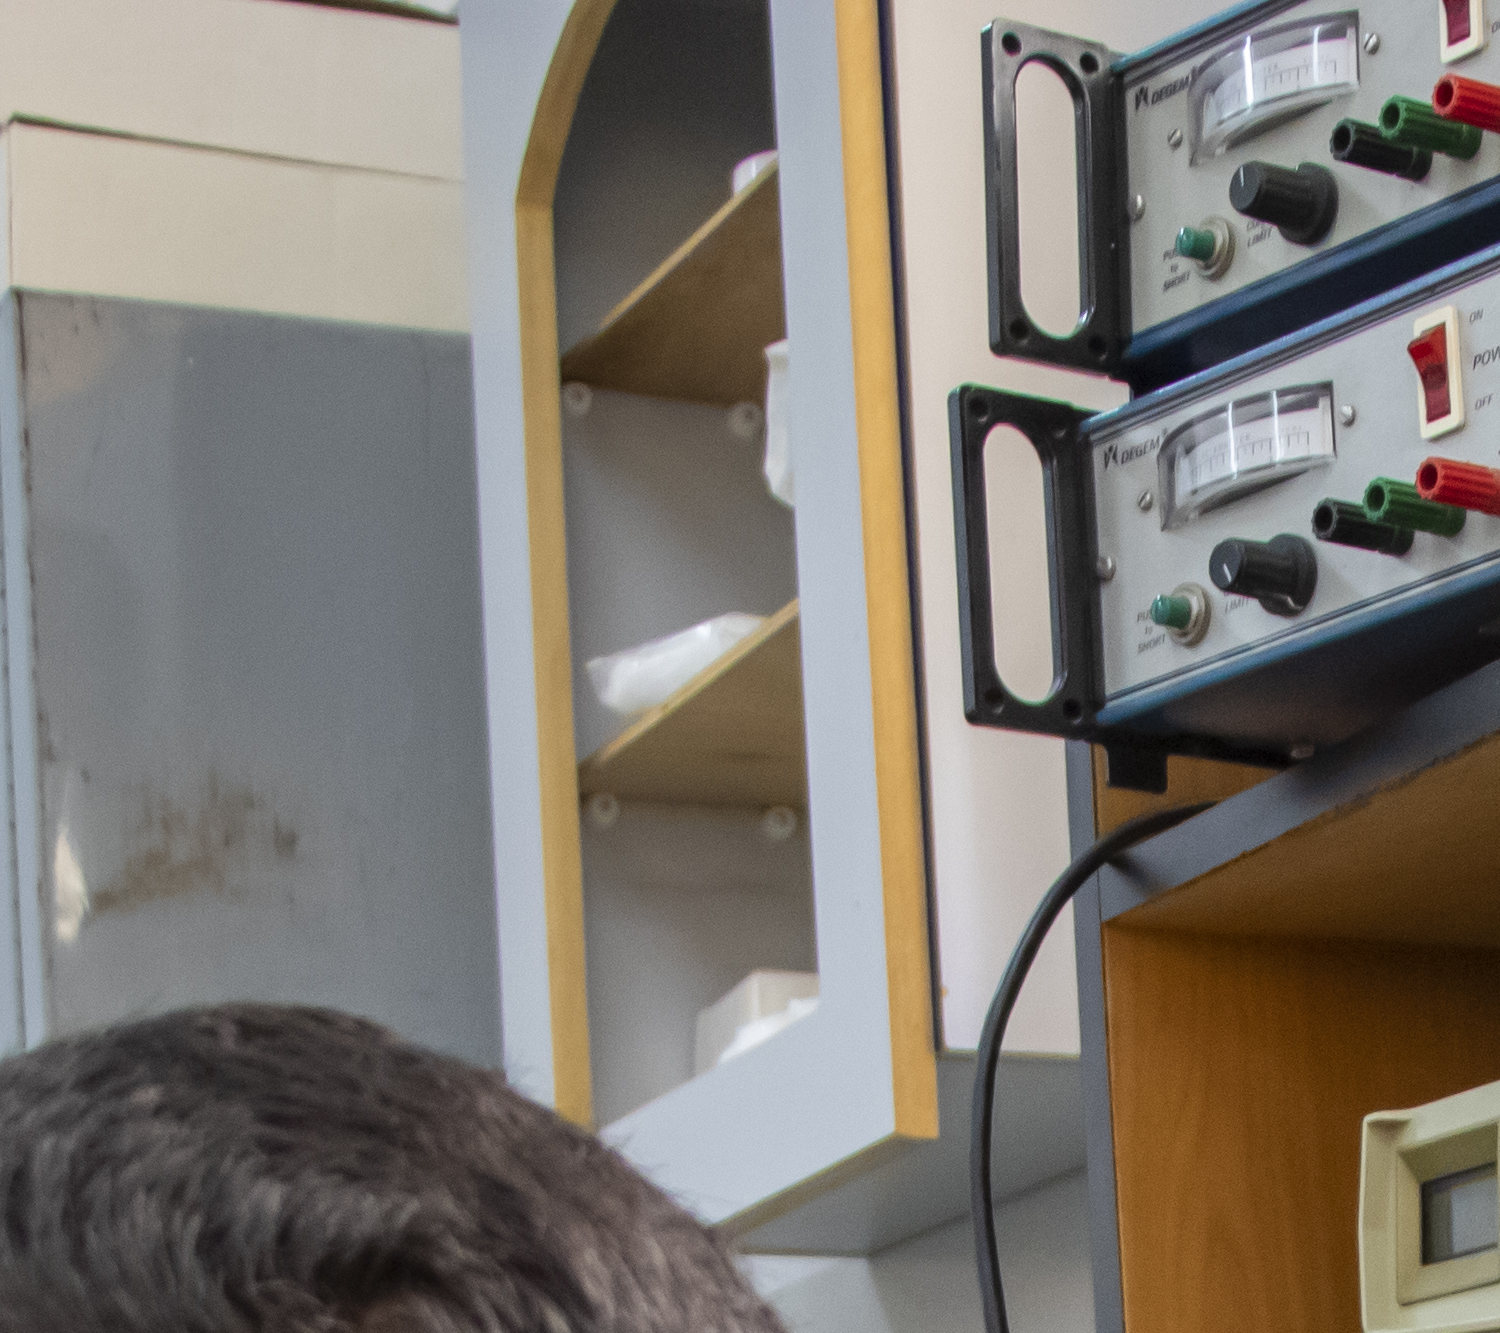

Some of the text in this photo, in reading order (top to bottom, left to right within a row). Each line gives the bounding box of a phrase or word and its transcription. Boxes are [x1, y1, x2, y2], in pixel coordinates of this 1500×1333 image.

[1151, 75, 1189, 107] DEGEM
[1474, 394, 1493, 411] OFF
[1120, 436, 1160, 467] DEGEM
